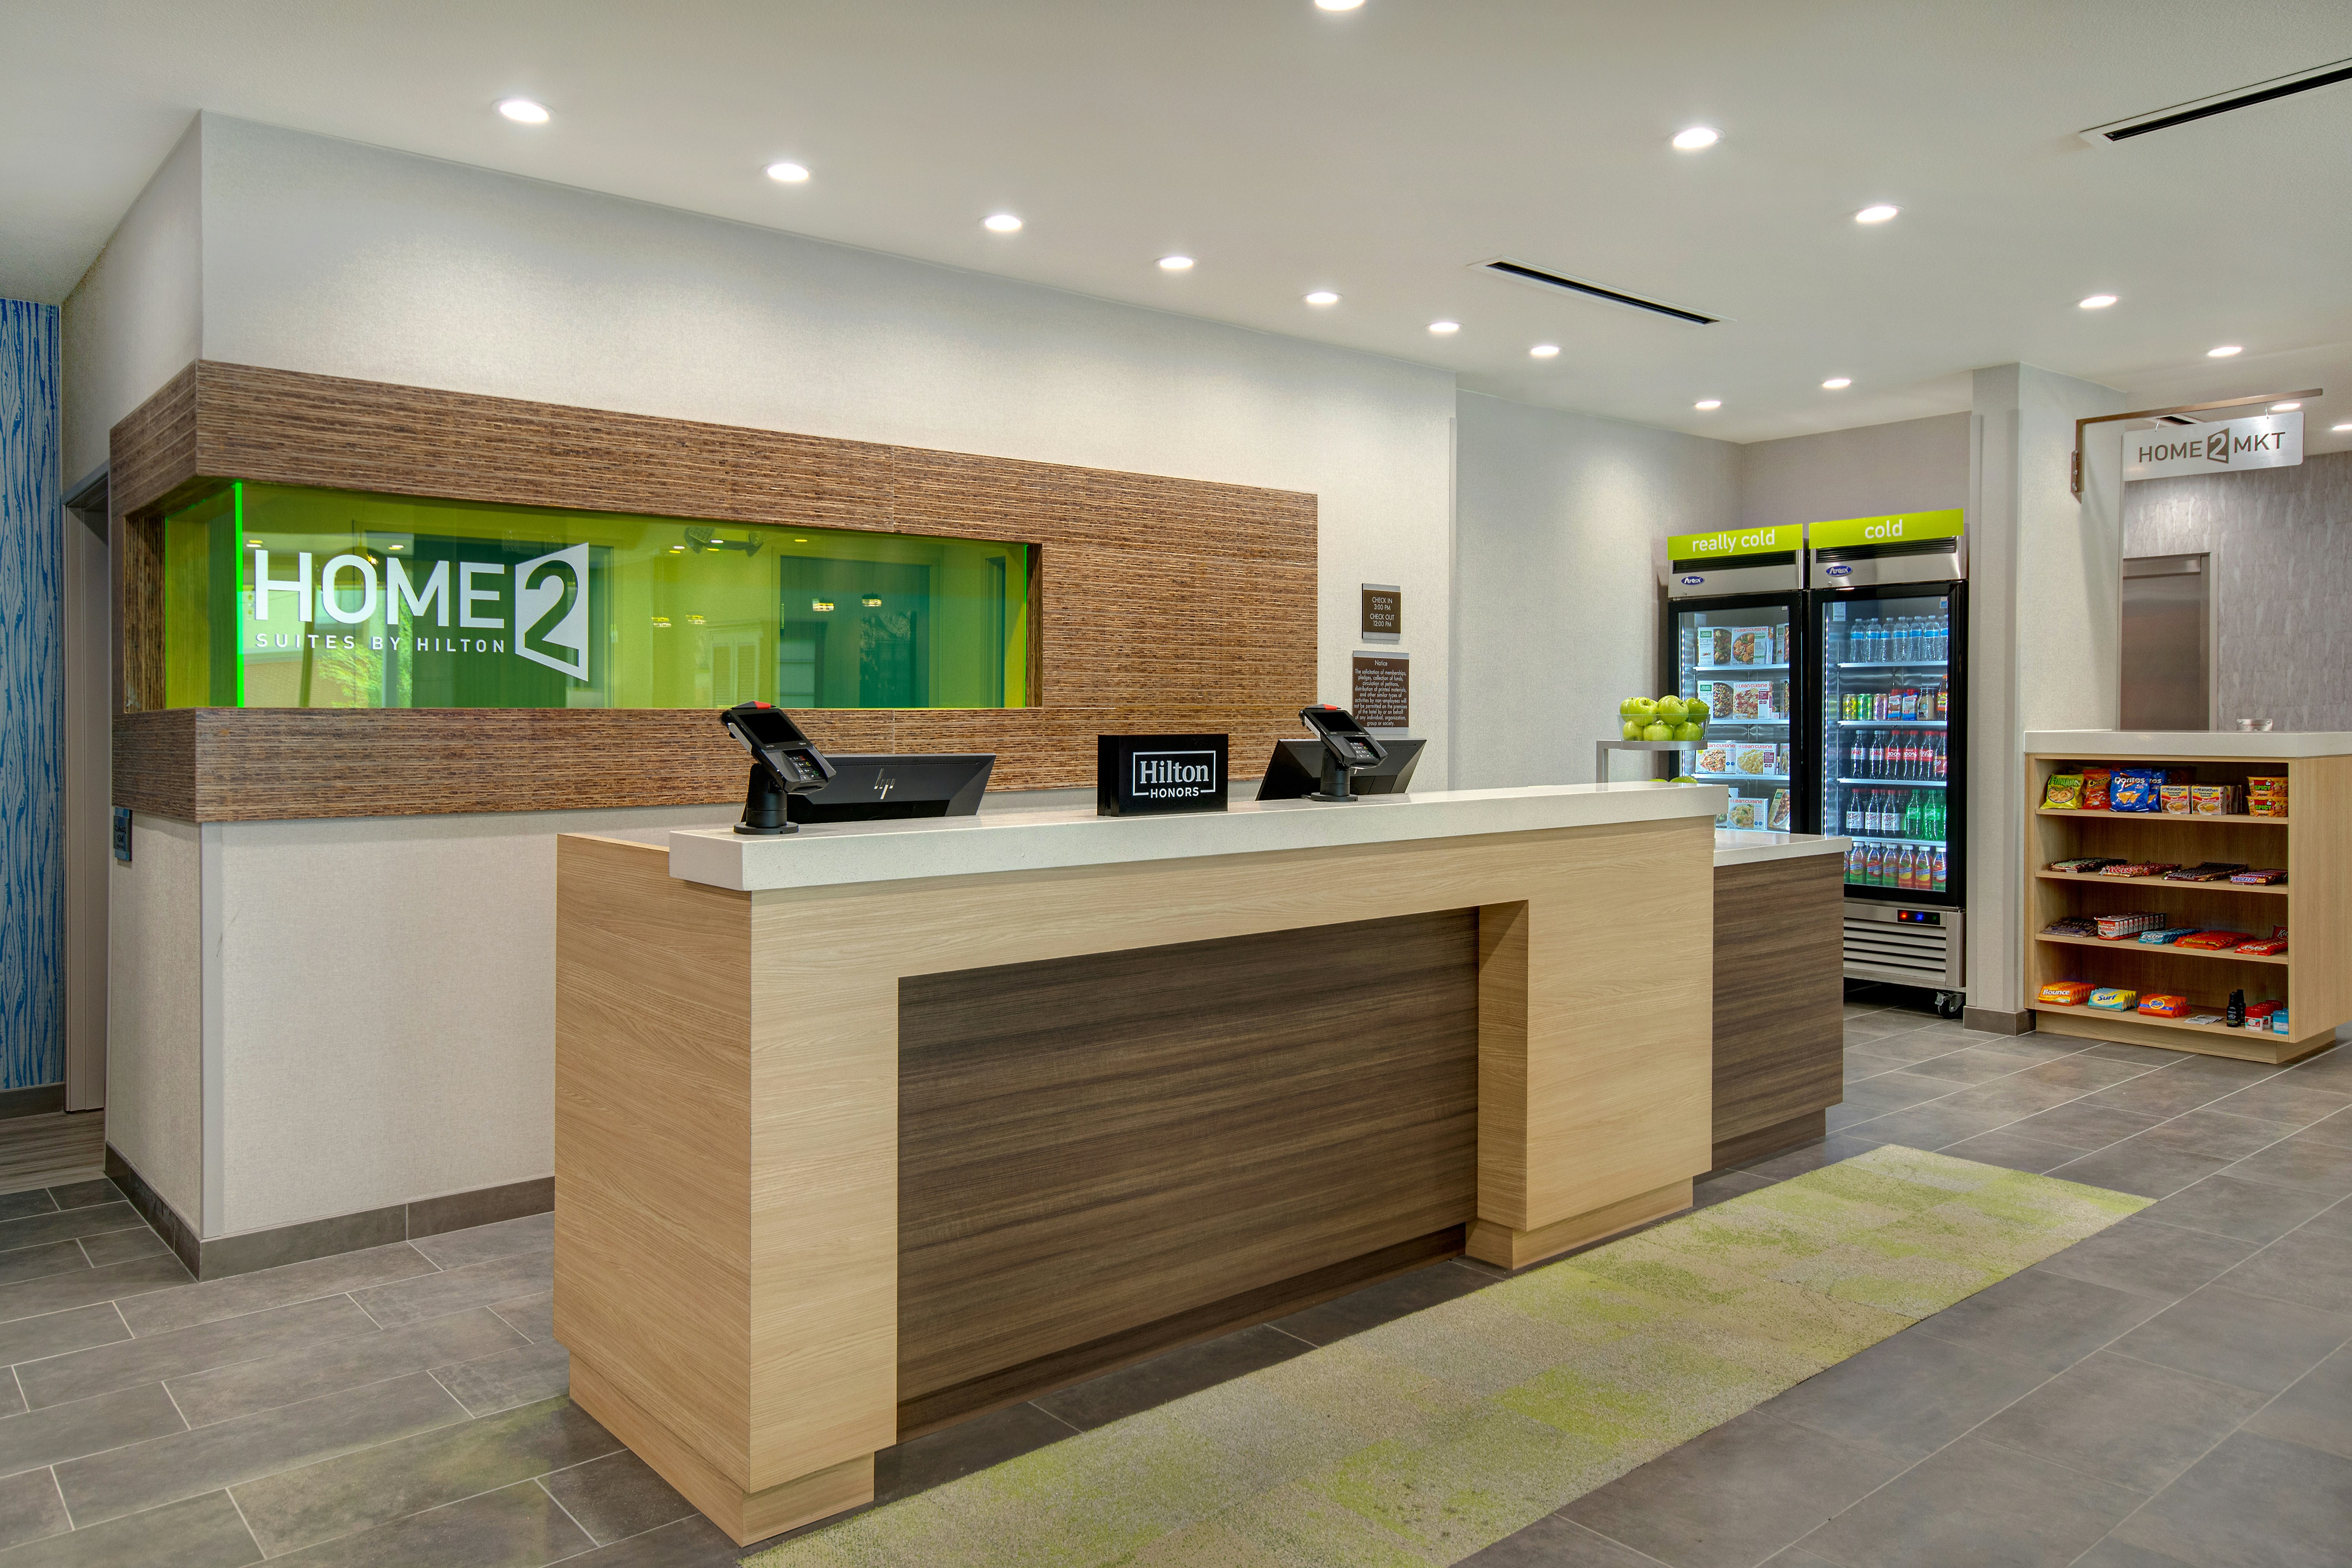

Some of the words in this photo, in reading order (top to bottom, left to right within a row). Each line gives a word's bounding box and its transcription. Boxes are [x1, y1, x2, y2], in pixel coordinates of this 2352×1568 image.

[2139, 440, 2202, 463] HOME
[2234, 432, 2285, 454] MKT
[1693, 532, 1737, 553] really
[1741, 529, 1775, 547] cold
[1865, 519, 1903, 539] cold
[255, 549, 505, 628] HOME
[256, 633, 355, 650] SUITES
[372, 636, 400, 651] BY
[417, 638, 505, 653] HILTON
[1140, 760, 1209, 784] Hilton
[1151, 787, 1199, 798] HONORS
